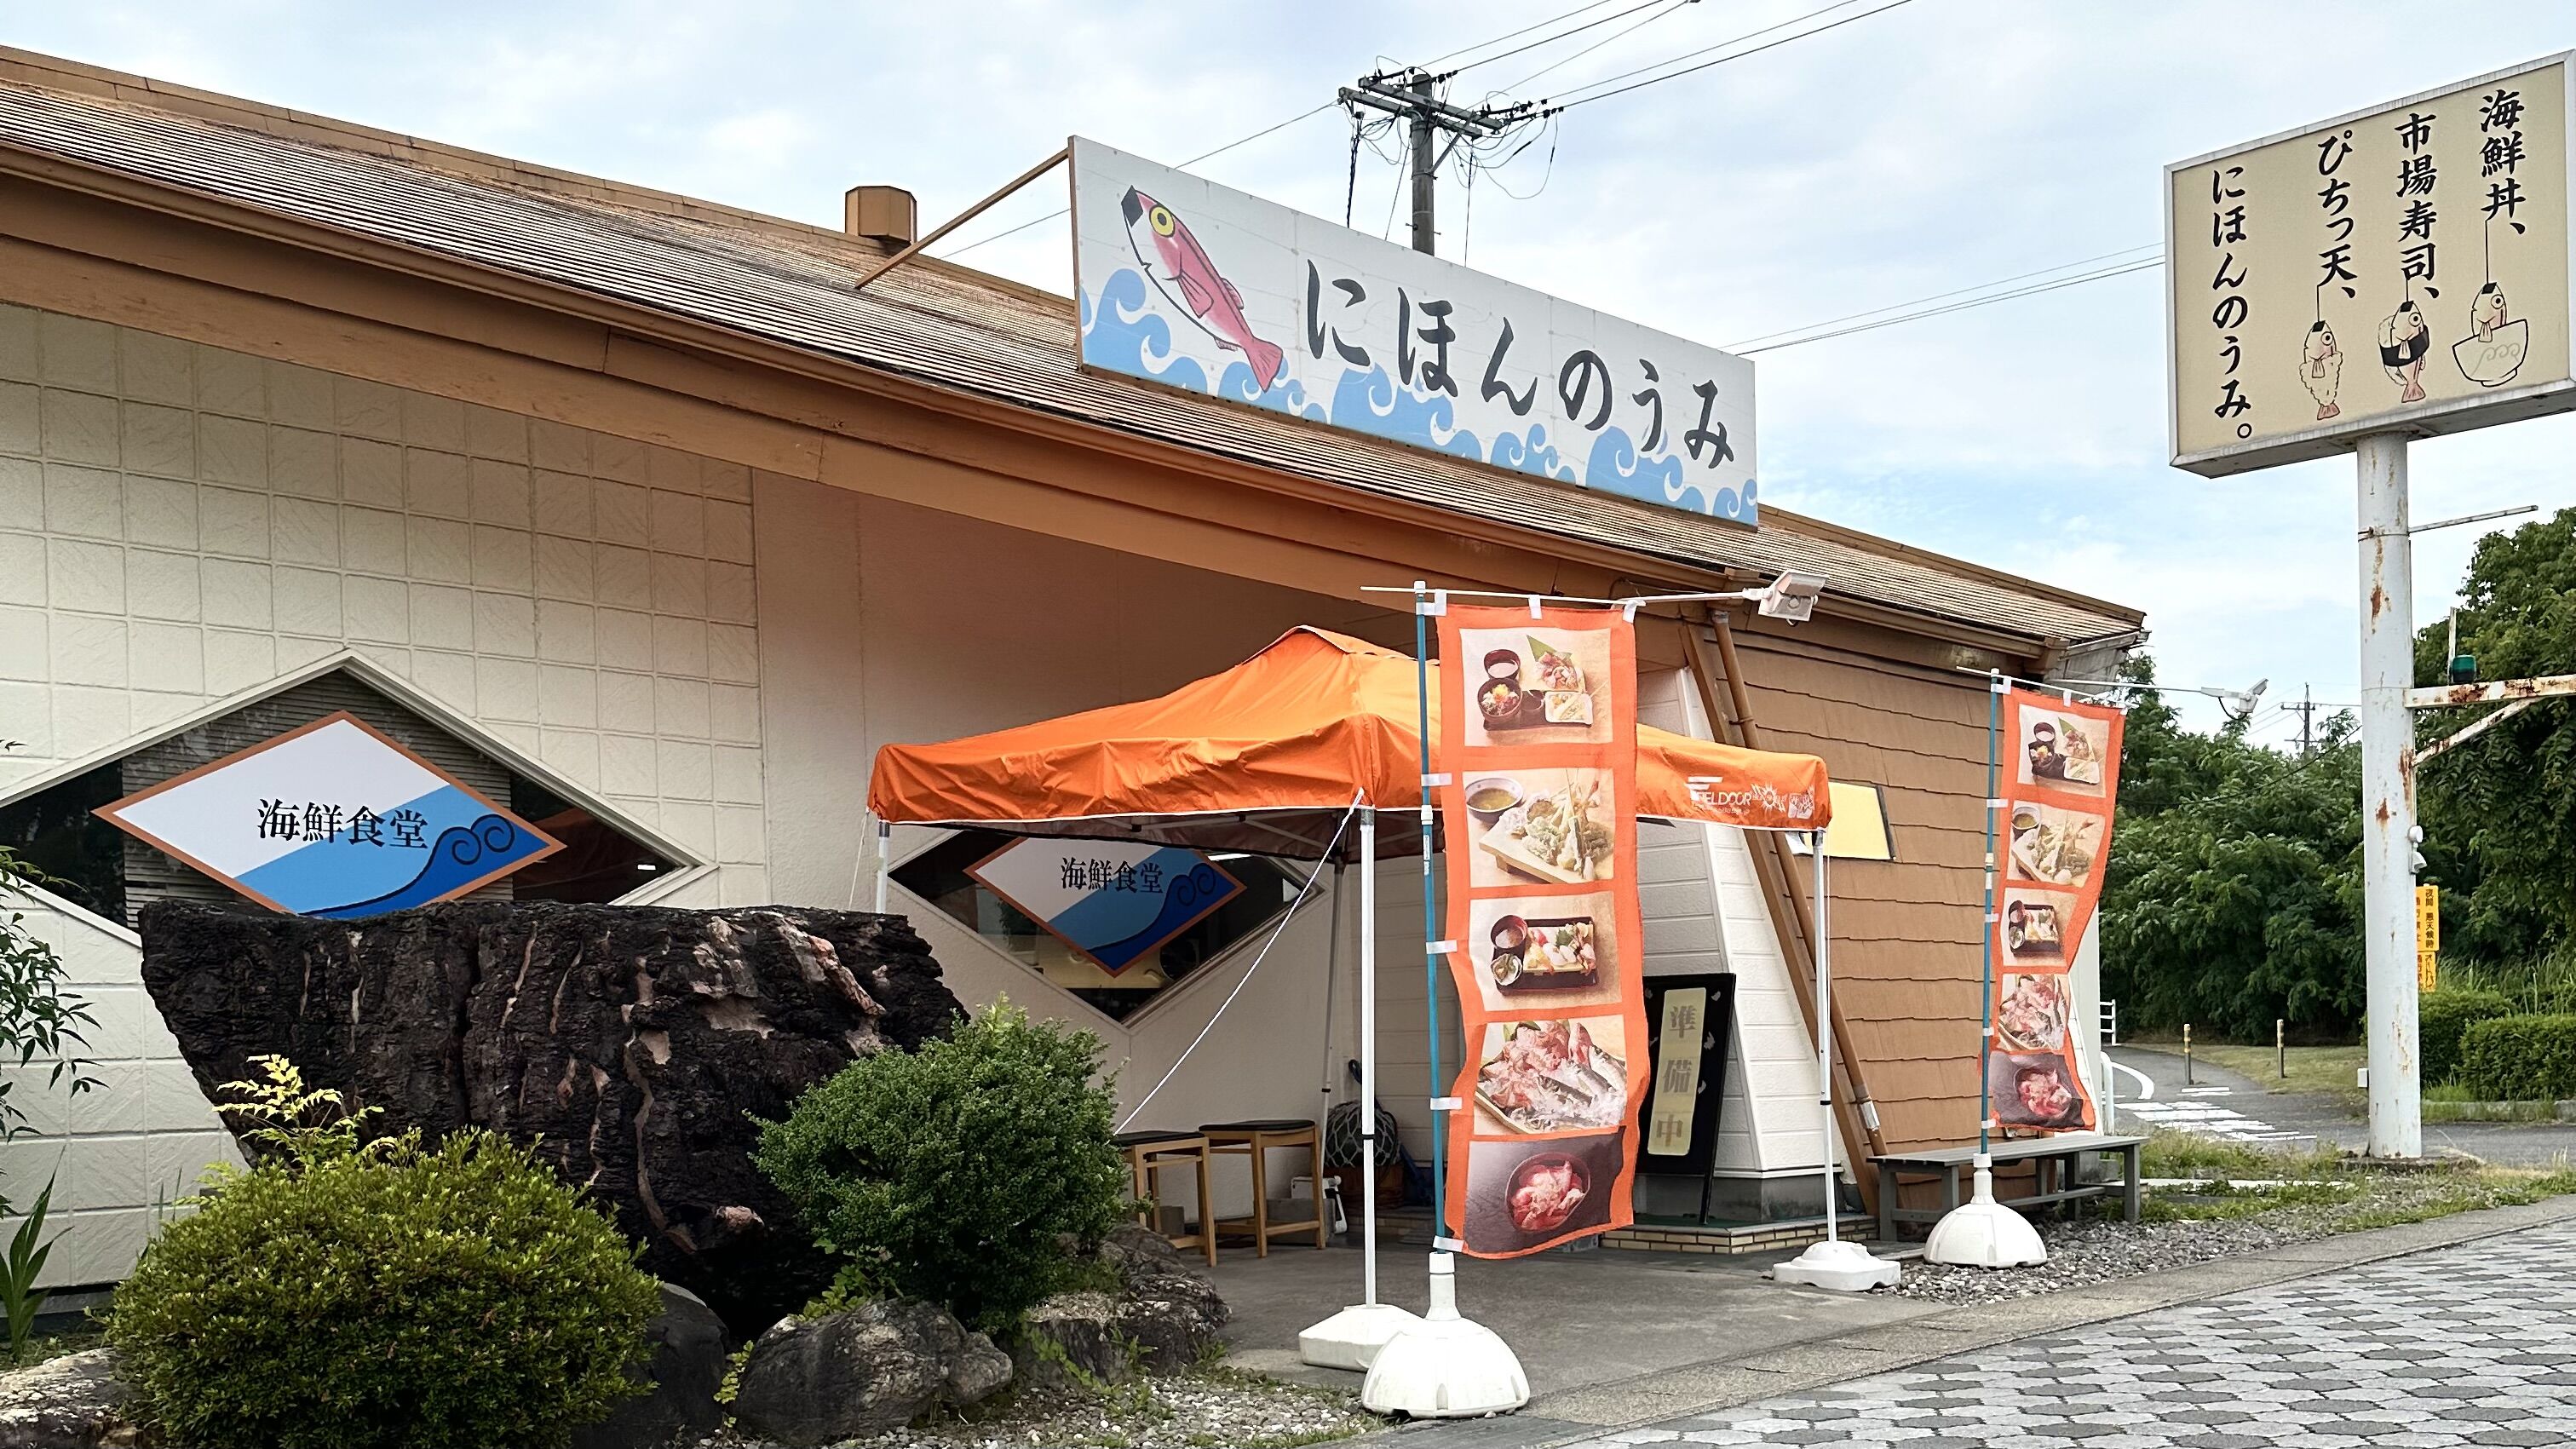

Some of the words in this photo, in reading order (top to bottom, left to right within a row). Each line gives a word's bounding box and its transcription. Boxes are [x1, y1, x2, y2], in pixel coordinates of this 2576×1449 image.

[2317, 129, 2359, 299] ぴちっ天、
[2394, 112, 2441, 299] 市場寿司、
[2479, 89, 2527, 235] 海鮮丼、
[1306, 258, 1735, 470] にほんのうみ
[2211, 165, 2253, 440] にほんのうみ。
[256, 797, 428, 849] 海鮮食堂
[1060, 856, 1164, 894] 海鮮食堂
[1655, 1004, 1698, 1147] 準備中
